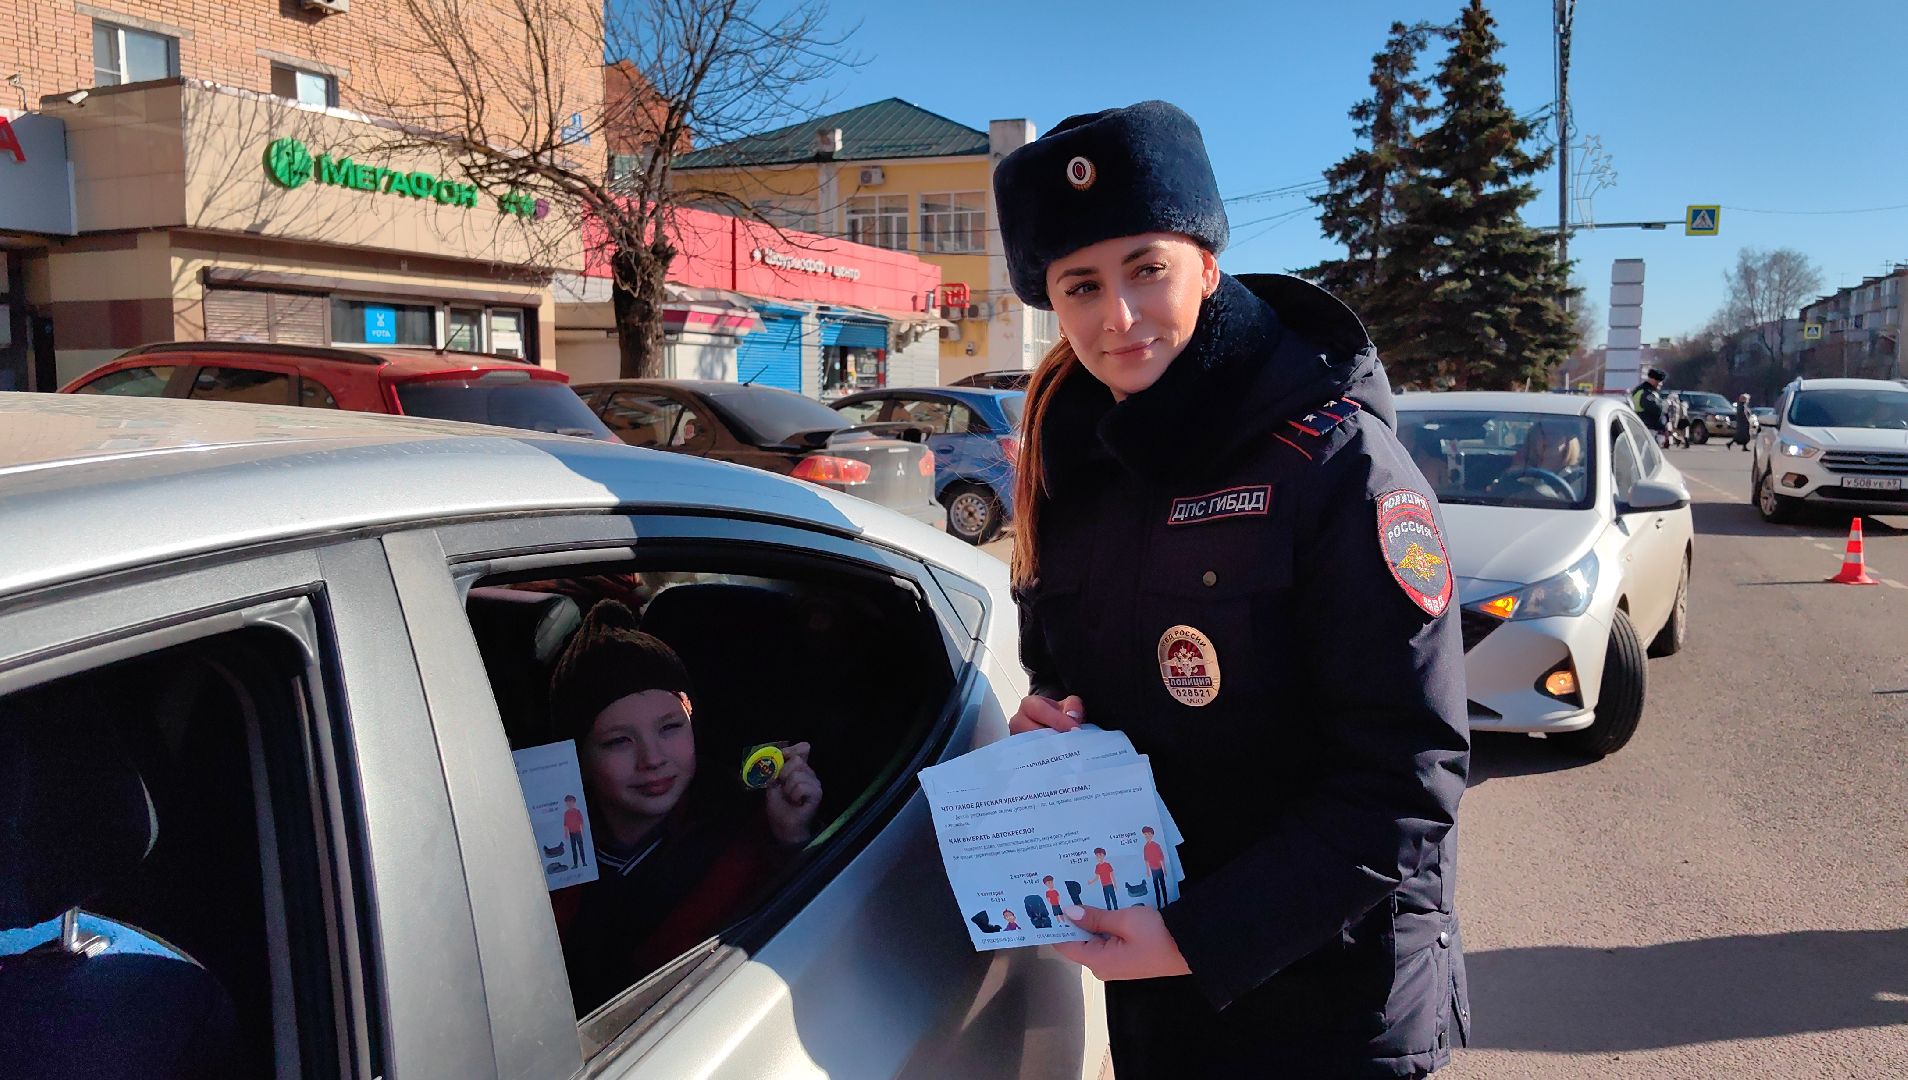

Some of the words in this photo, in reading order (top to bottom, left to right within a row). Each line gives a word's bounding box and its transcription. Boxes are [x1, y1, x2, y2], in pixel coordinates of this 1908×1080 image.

[1171, 501, 1206, 522] ДПС
[1208, 491, 1265, 514] ГИБДД
[1382, 493, 1428, 515] ПОЛИЦИЯ
[1388, 521, 1433, 542] РОССИЯ
[1423, 595, 1445, 613] МВД
[1174, 629, 1207, 647] РОССИИ
[1170, 677, 1211, 687] ПОЛИЦИЯ
[1176, 688, 1211, 698] 028521
